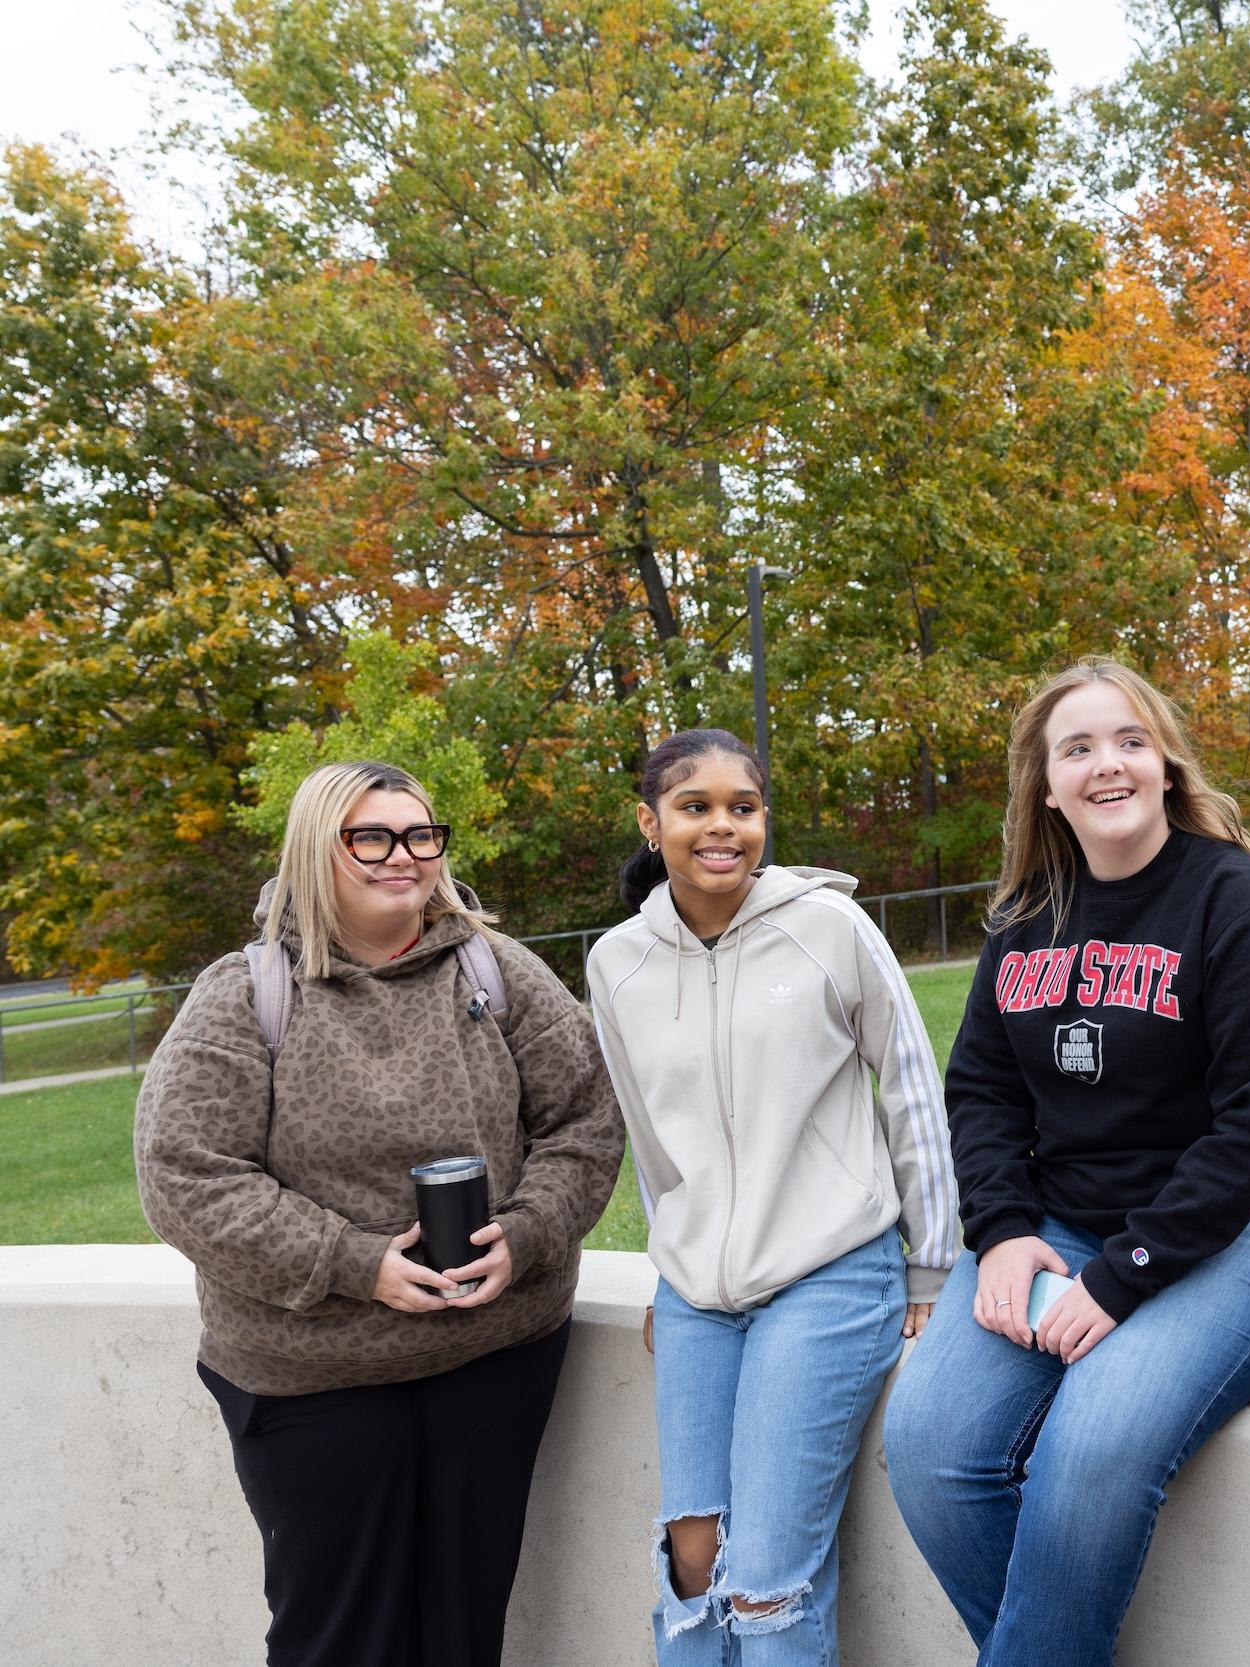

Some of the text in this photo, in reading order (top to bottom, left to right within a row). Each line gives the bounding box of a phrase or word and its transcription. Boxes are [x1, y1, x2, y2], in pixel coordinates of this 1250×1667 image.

[995, 939, 1182, 1021] OHIO STATE
[1068, 1027, 1089, 1043] OUR
[1061, 1042, 1093, 1057] HONOR
[1061, 1057, 1096, 1072] DEFEND
